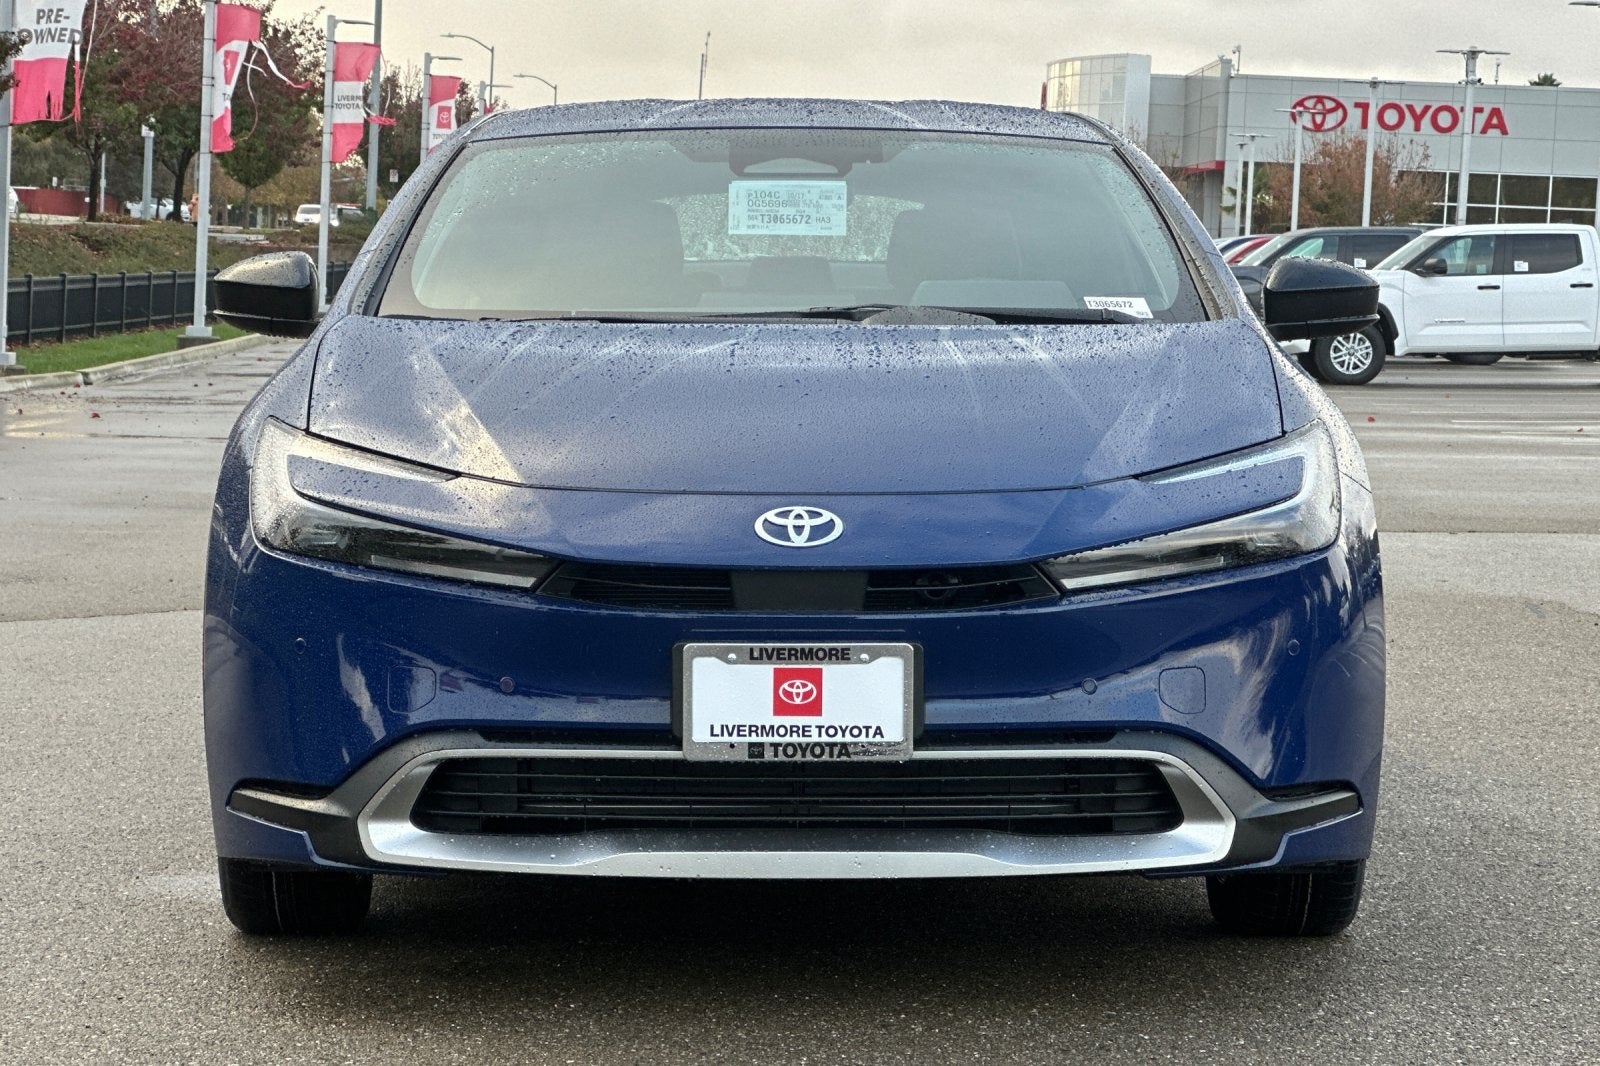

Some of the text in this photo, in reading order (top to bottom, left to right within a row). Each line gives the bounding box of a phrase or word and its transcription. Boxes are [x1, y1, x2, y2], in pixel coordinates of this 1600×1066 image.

[36, 8, 70, 25] PRE-
[18, 27, 83, 45] OWNED
[759, 213, 812, 225] T3065672
[1087, 300, 1134, 309] T3065672
[749, 647, 851, 661] LIVERMORE
[710, 724, 885, 739] LIVERMORE TOYOTA
[770, 742, 852, 759] TOYOTA
